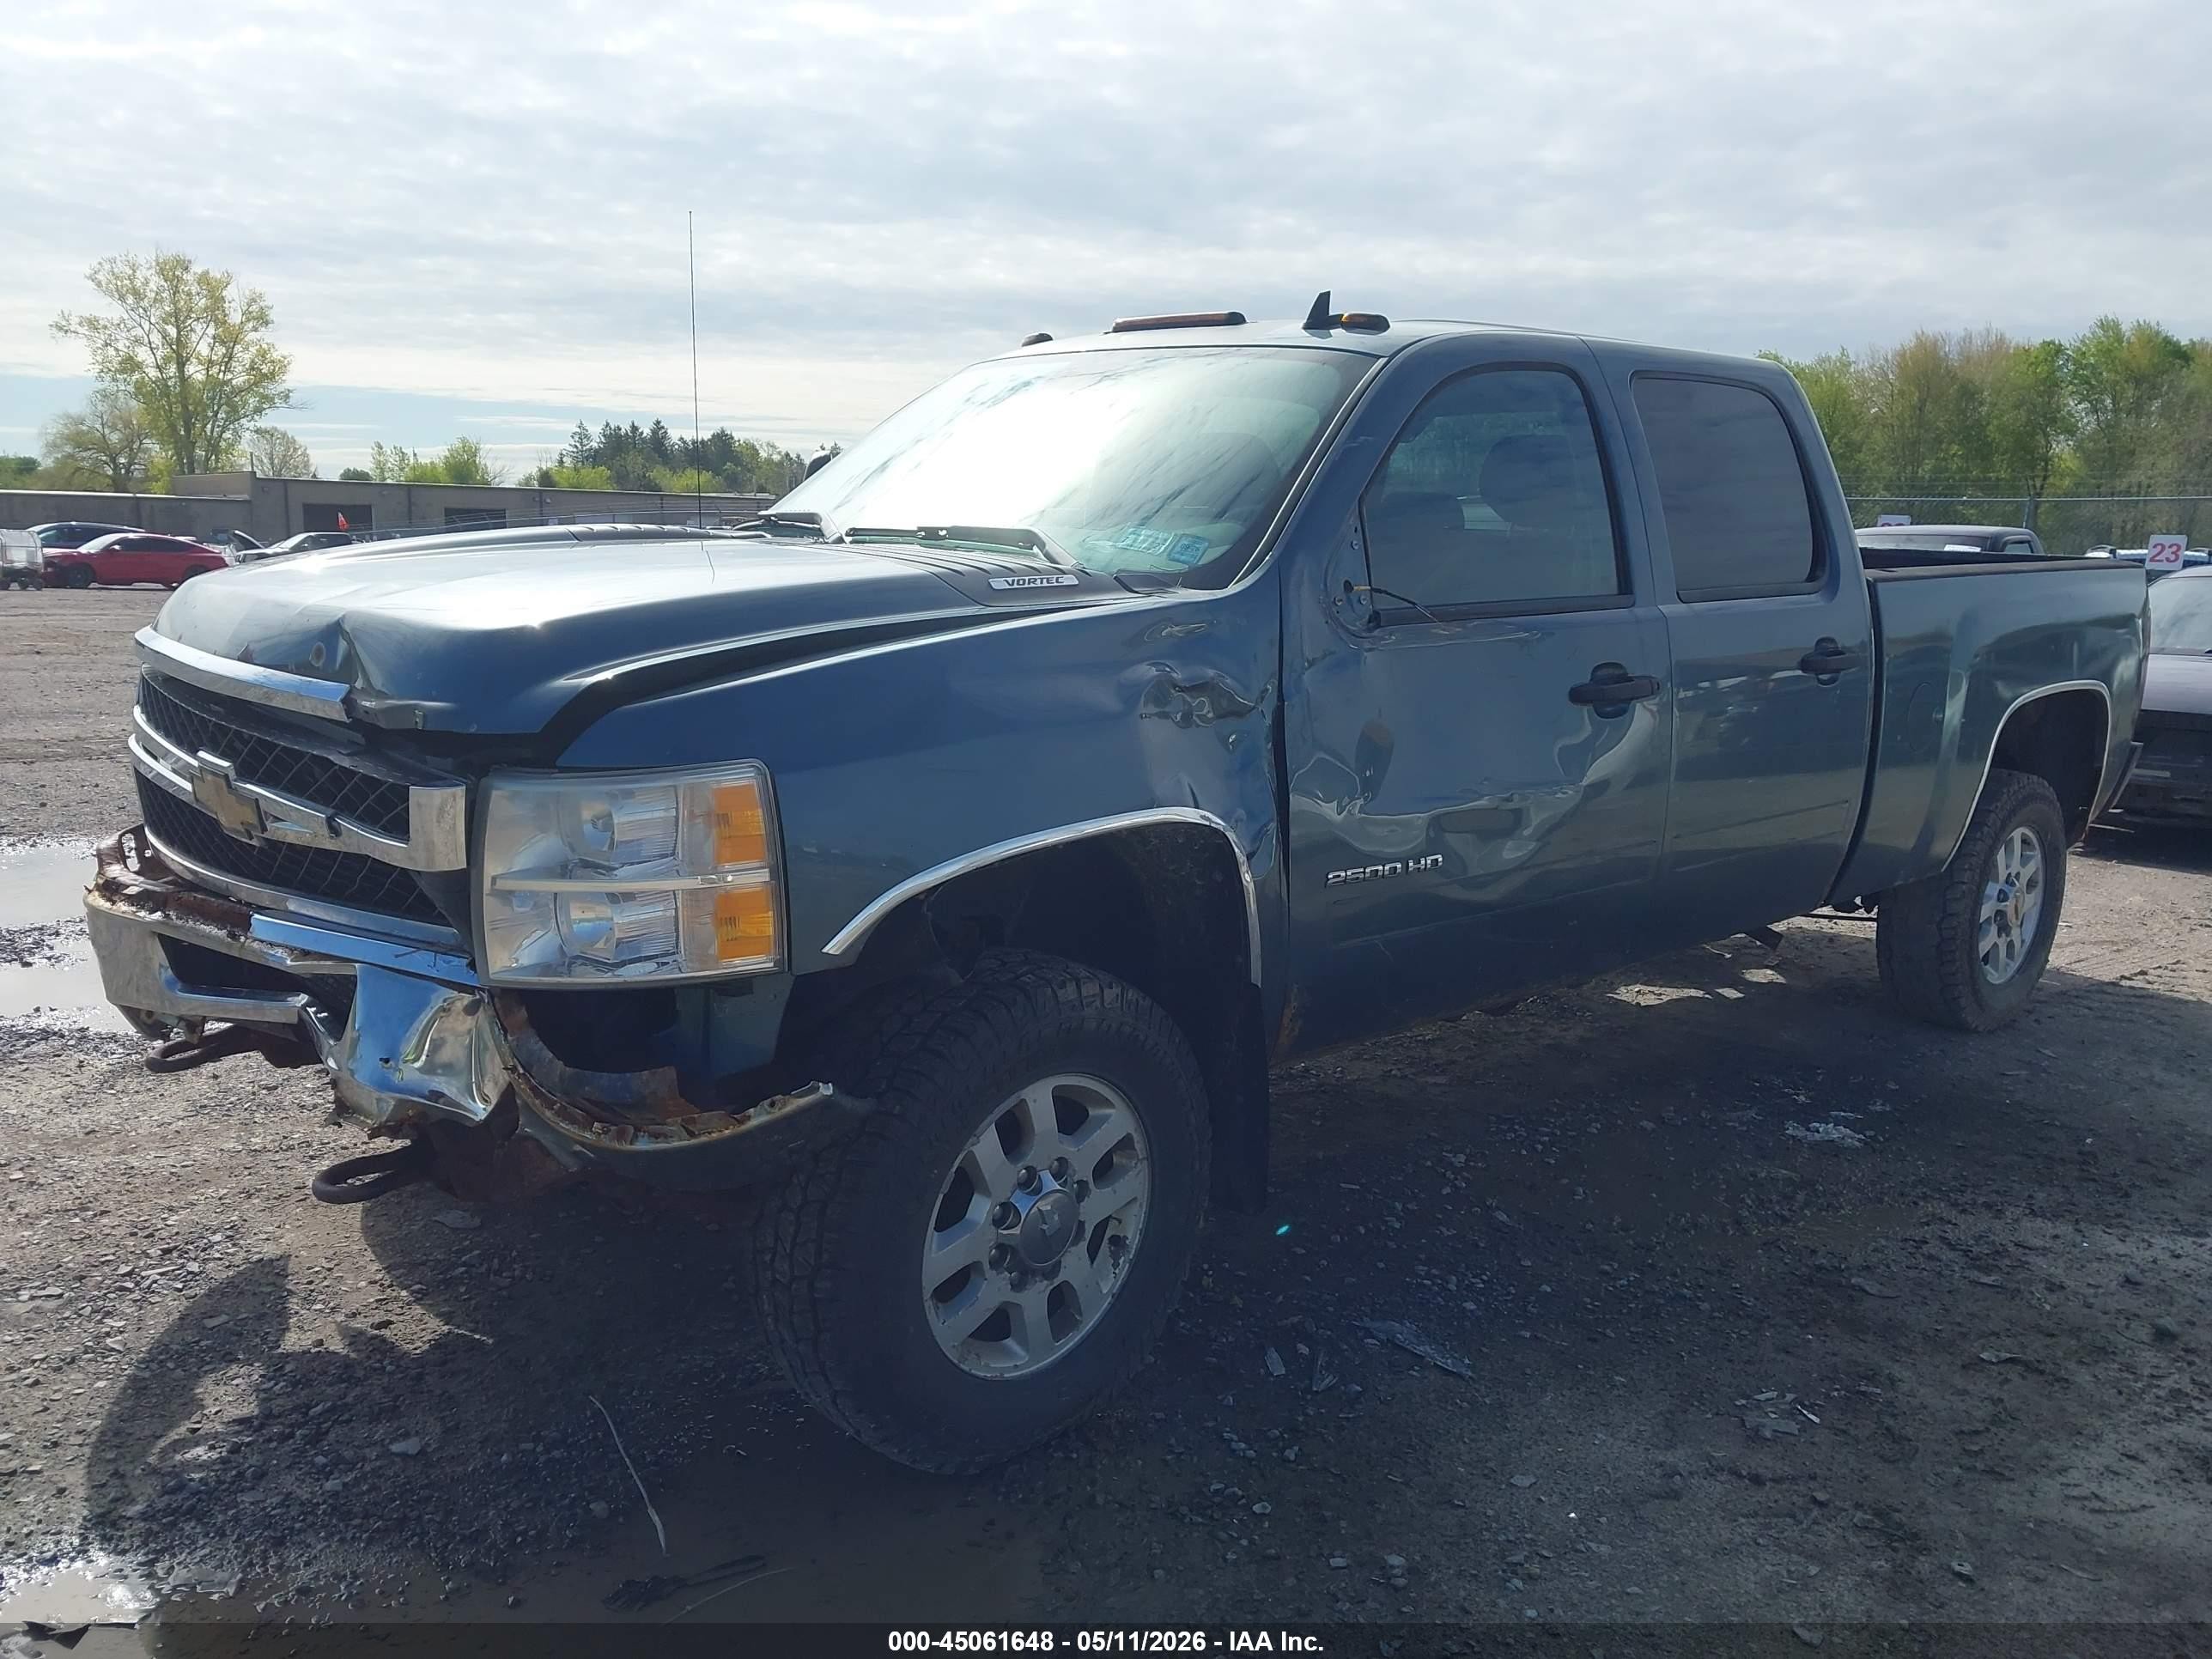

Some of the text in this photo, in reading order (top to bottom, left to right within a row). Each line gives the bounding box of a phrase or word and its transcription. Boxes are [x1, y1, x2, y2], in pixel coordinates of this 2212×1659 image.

[2149, 543, 2182, 562] 23
[1003, 576, 1065, 586] VORTEC
[1327, 854, 1443, 886] 2500 HD
